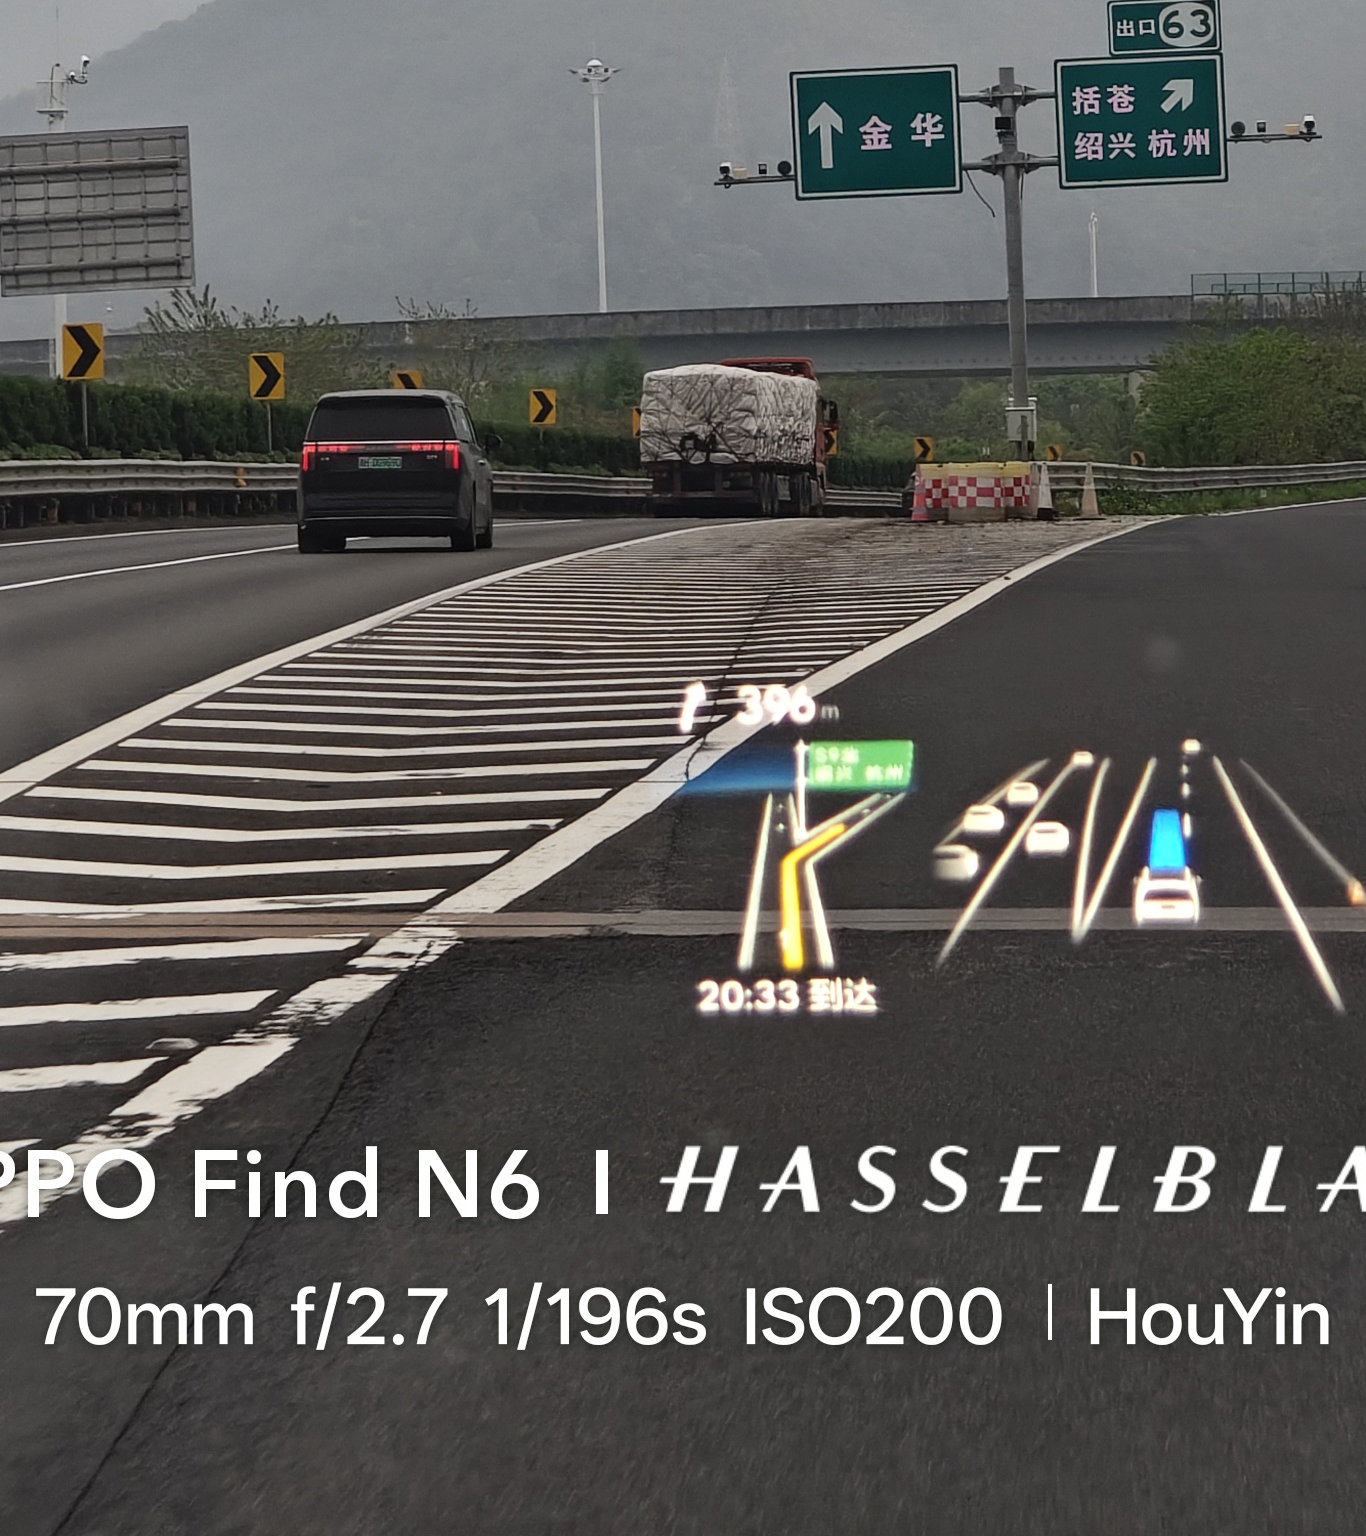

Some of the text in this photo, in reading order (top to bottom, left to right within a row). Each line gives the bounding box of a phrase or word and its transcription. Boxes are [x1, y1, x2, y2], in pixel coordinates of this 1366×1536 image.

[1116, 9, 1212, 39] 出口 63
[1071, 84, 1135, 115] 括苍
[858, 112, 945, 151] 金华
[1074, 128, 1210, 161] 绍兴 杭州
[737, 683, 840, 726] 396 m
[697, 976, 878, 1012] 20:33 到达
